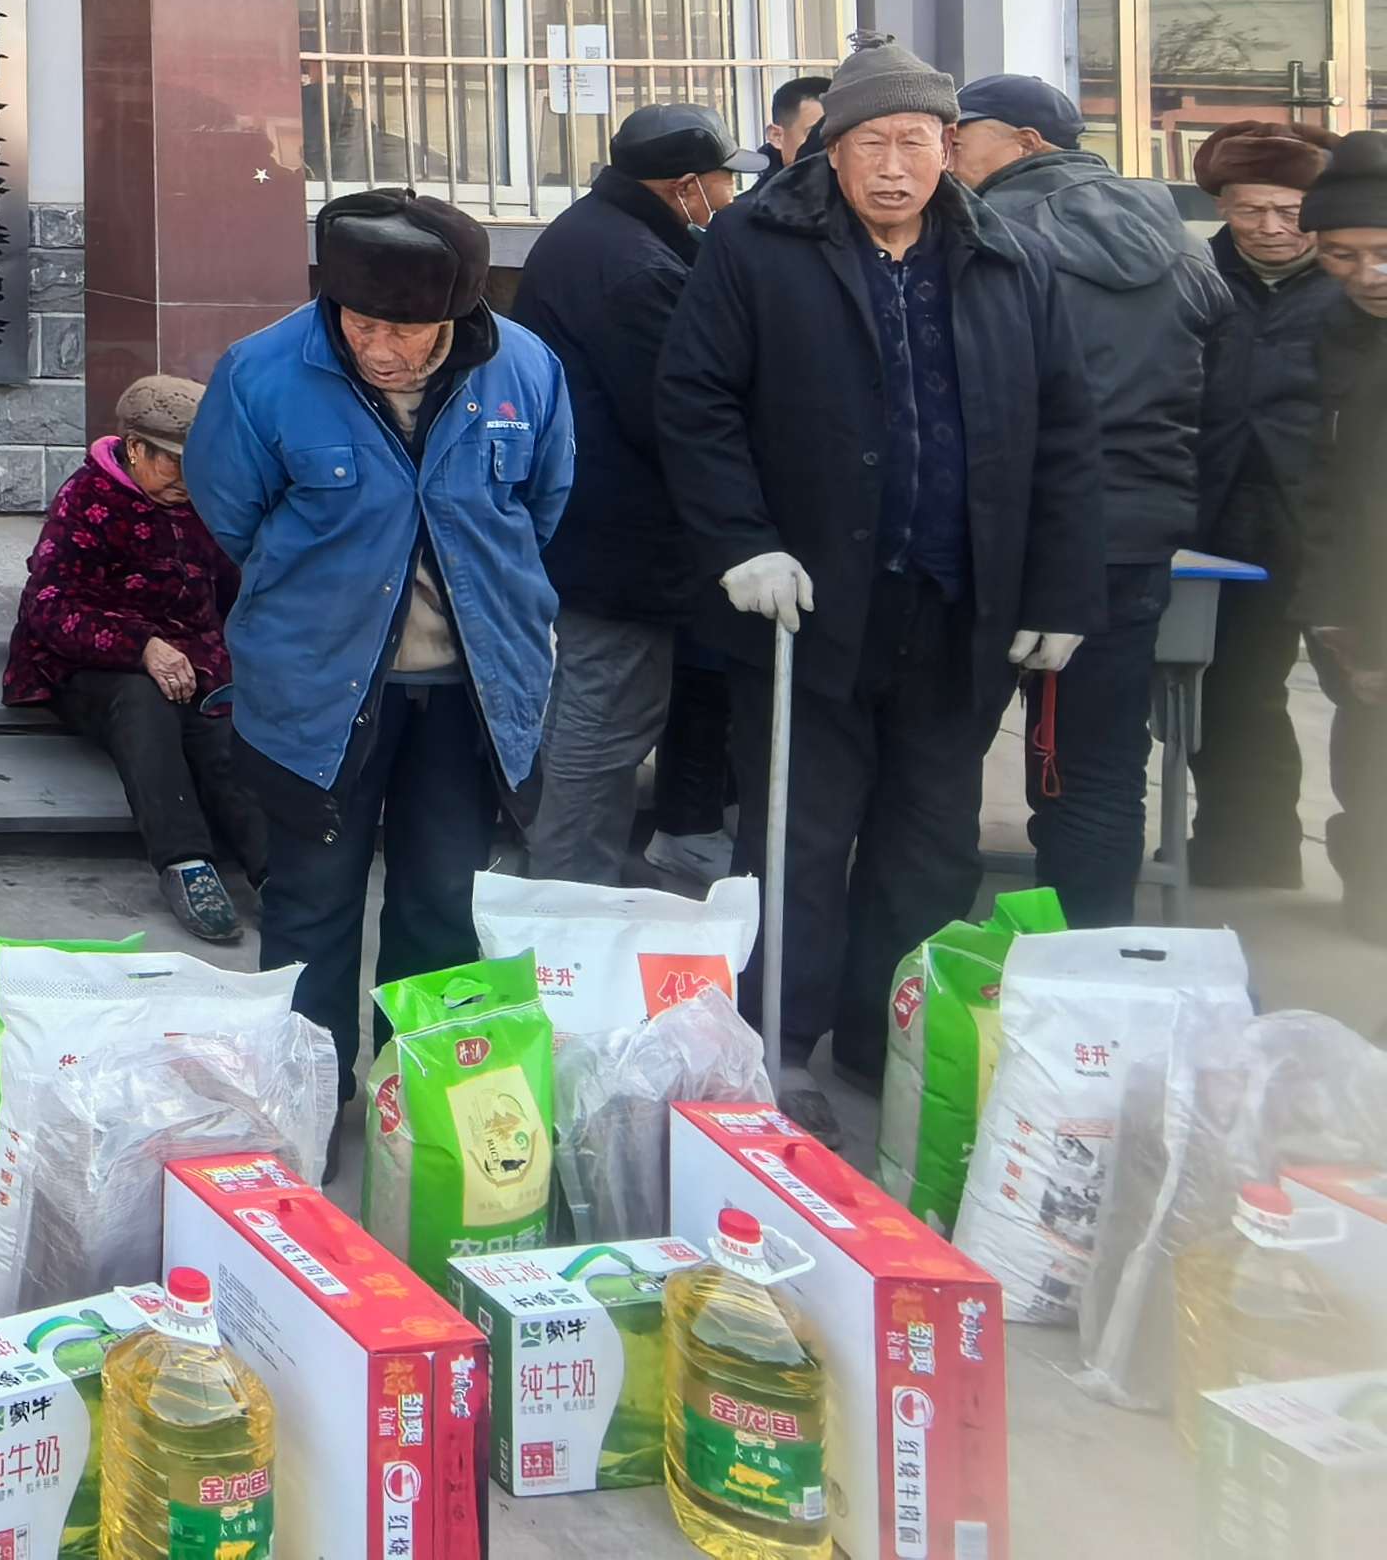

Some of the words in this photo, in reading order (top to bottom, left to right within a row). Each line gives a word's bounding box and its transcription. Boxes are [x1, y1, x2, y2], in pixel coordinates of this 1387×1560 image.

[545, 1318, 588, 1344] 蒙牛
[520, 1358, 597, 1402] 纯牛奶
[9, 1395, 53, 1426] 蒙牛
[709, 1391, 799, 1439] 金龙鱼
[198, 1467, 272, 1506] 金龙鱼
[896, 1440, 925, 1546] 红烧牛肉面
